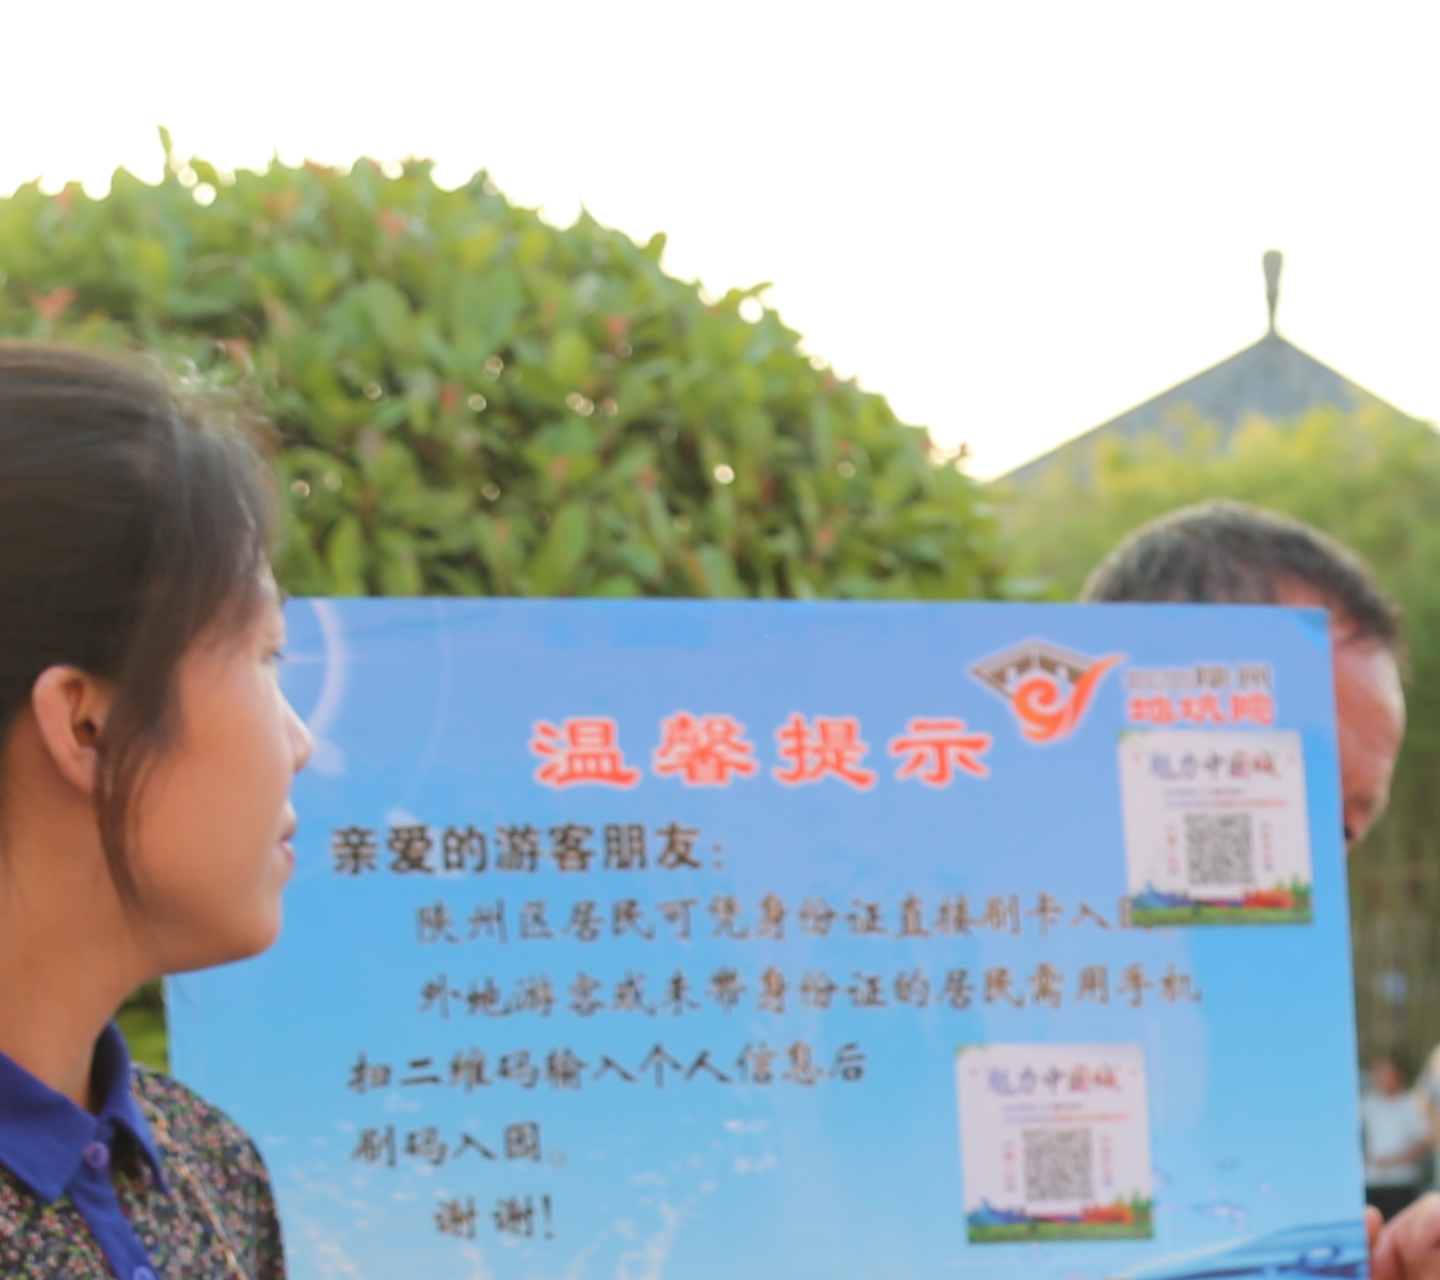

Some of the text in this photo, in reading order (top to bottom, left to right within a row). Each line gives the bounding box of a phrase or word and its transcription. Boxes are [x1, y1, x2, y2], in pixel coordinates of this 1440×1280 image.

[530, 711, 993, 790] 温馨提示
[416, 891, 1132, 945] 陕州区居民可凭身份证直接刷卡入
[347, 1038, 868, 1094] 扫二维码输入个人信息后
